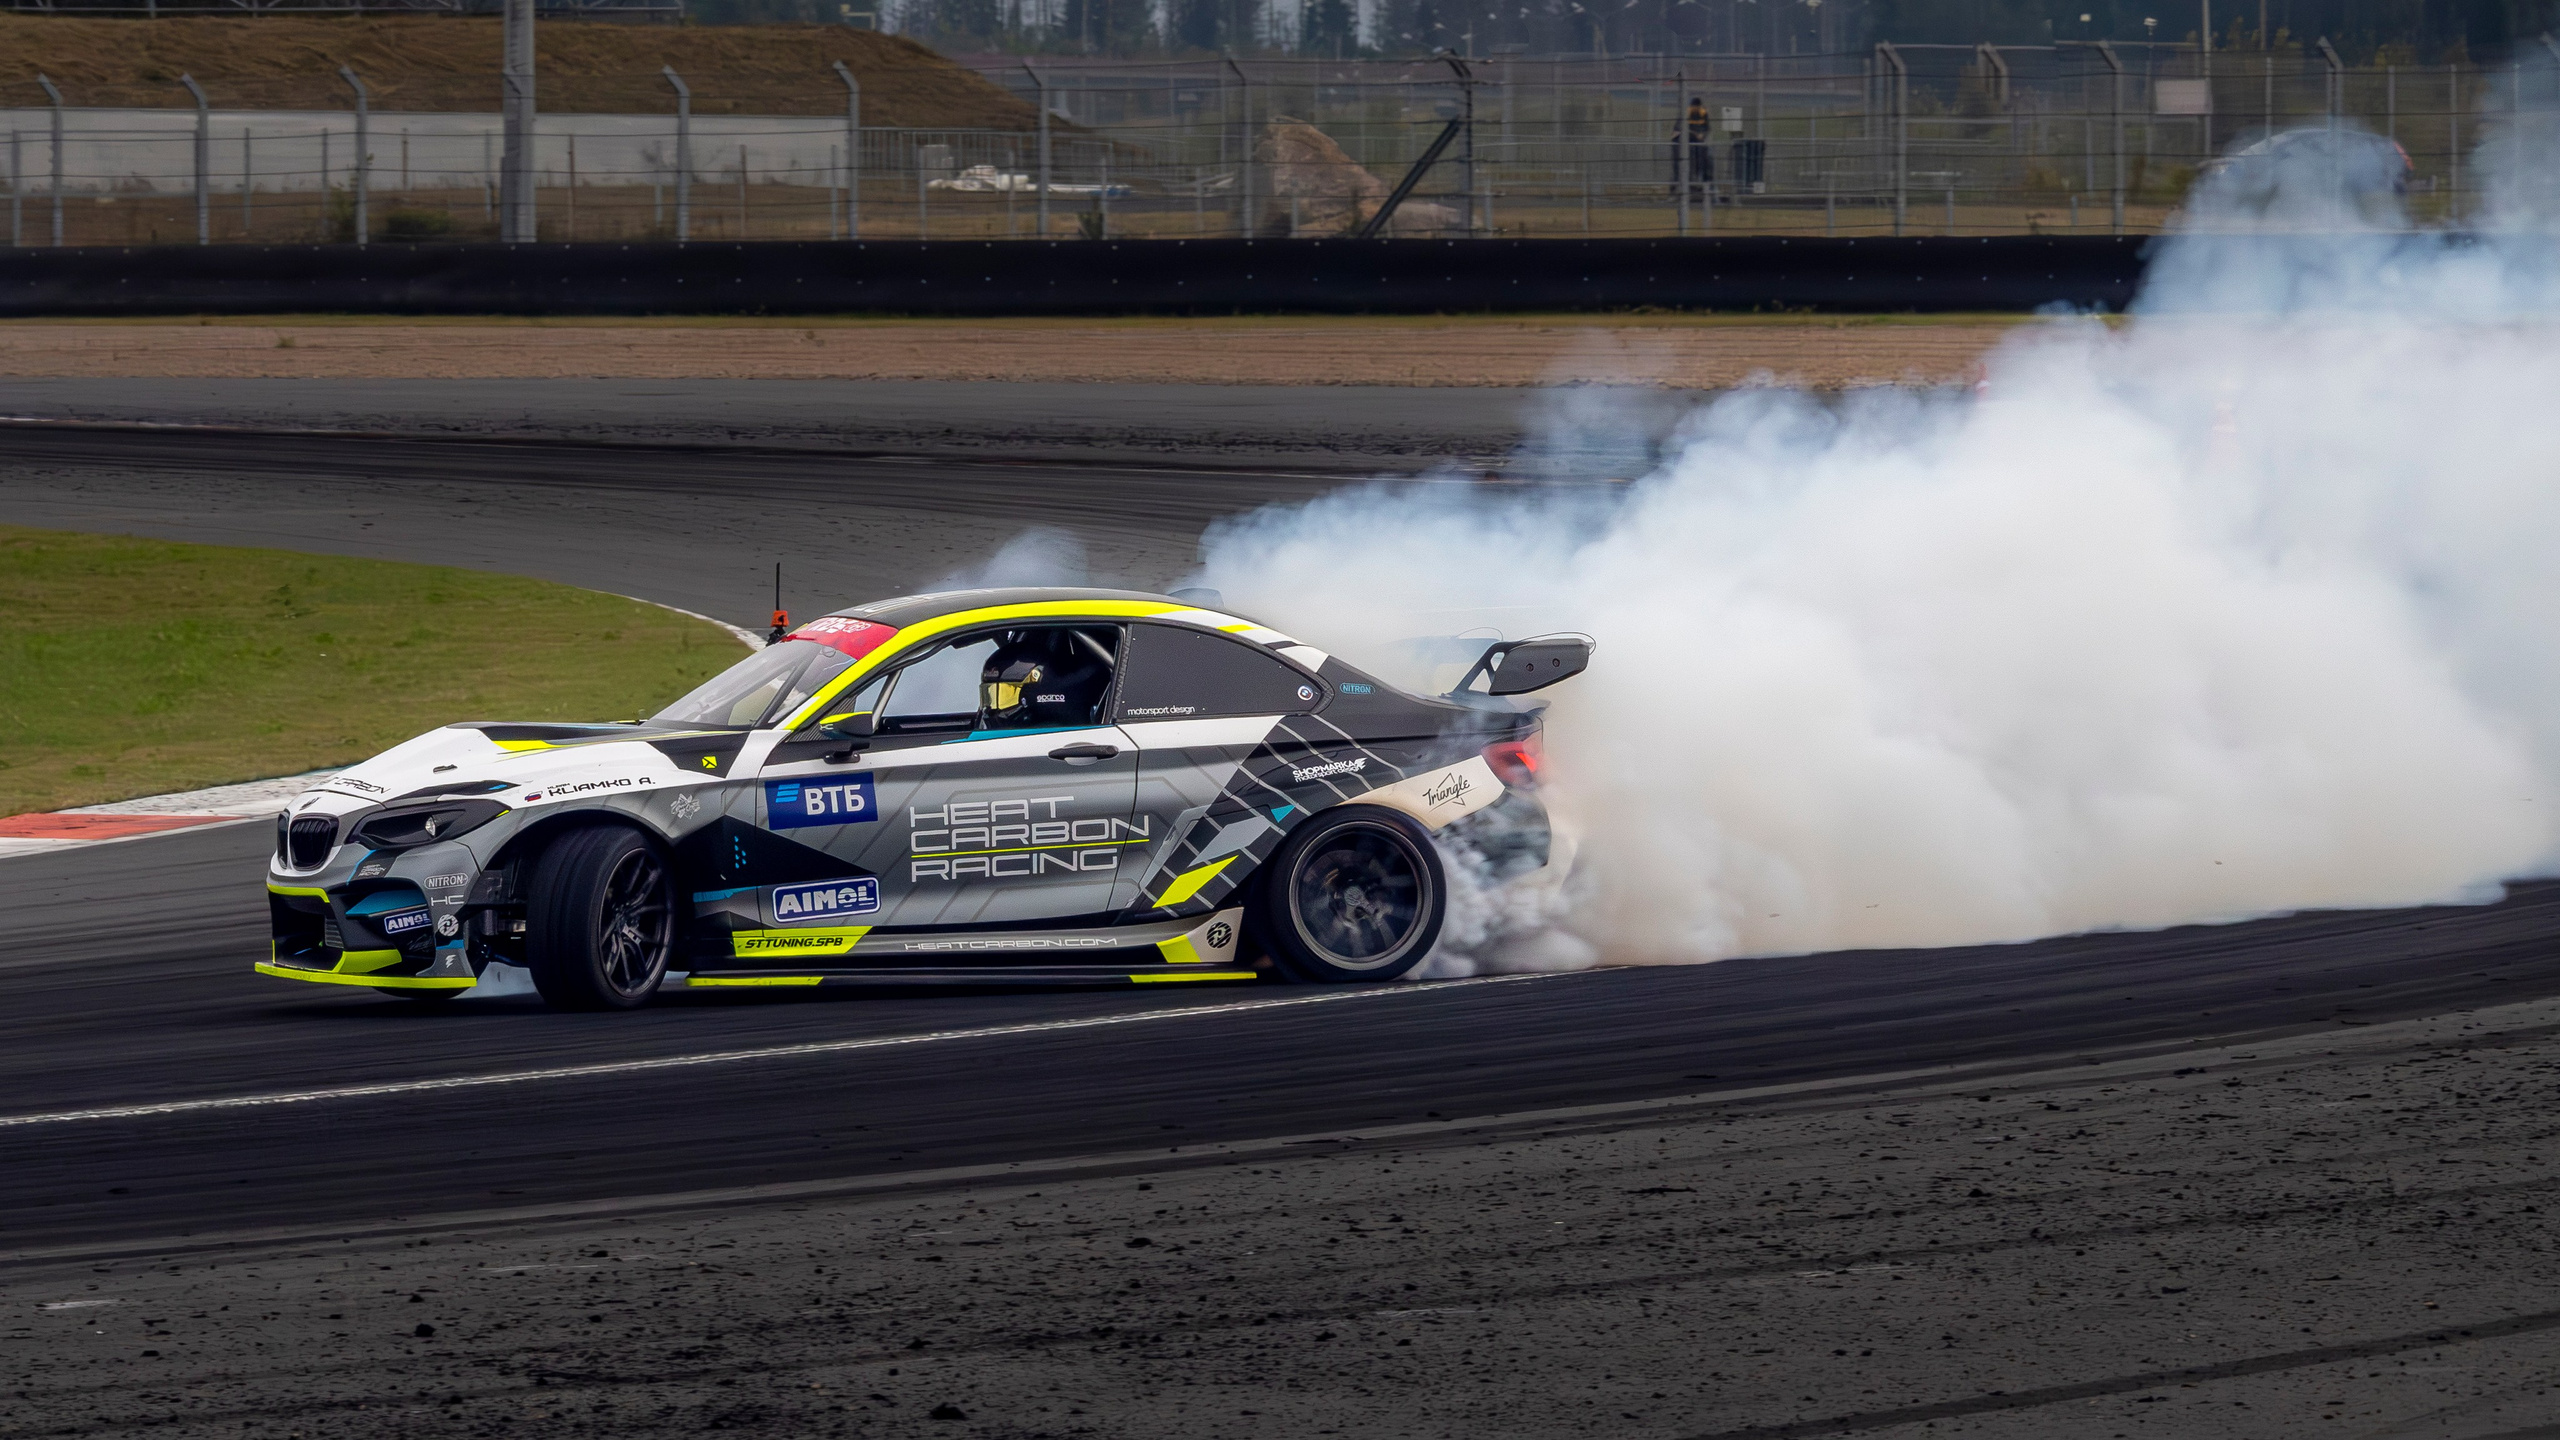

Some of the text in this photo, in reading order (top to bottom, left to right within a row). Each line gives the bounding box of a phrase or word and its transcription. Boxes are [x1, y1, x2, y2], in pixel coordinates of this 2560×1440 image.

[1342, 684, 1371, 693] NITRON
[1037, 694, 1065, 702] sparco
[1127, 705, 1195, 715] motorsport design
[1292, 760, 1355, 778] SHOPMARKA
[548, 779, 632, 797] KLIAMKO
[638, 777, 656, 785] A.
[1422, 774, 1470, 806] Triangle
[804, 784, 865, 816] ВТБ
[910, 796, 1075, 828] HEAT
[911, 815, 1149, 853] CARBON
[911, 848, 1118, 882] RACING
[428, 876, 464, 887] NITRON
[430, 895, 464, 906] HC
[778, 885, 875, 915] AIMOL
[388, 913, 431, 930] AIMOL
[745, 937, 844, 949] STTUNING.SPB
[904, 938, 1118, 950] HEATCARBON.COM
